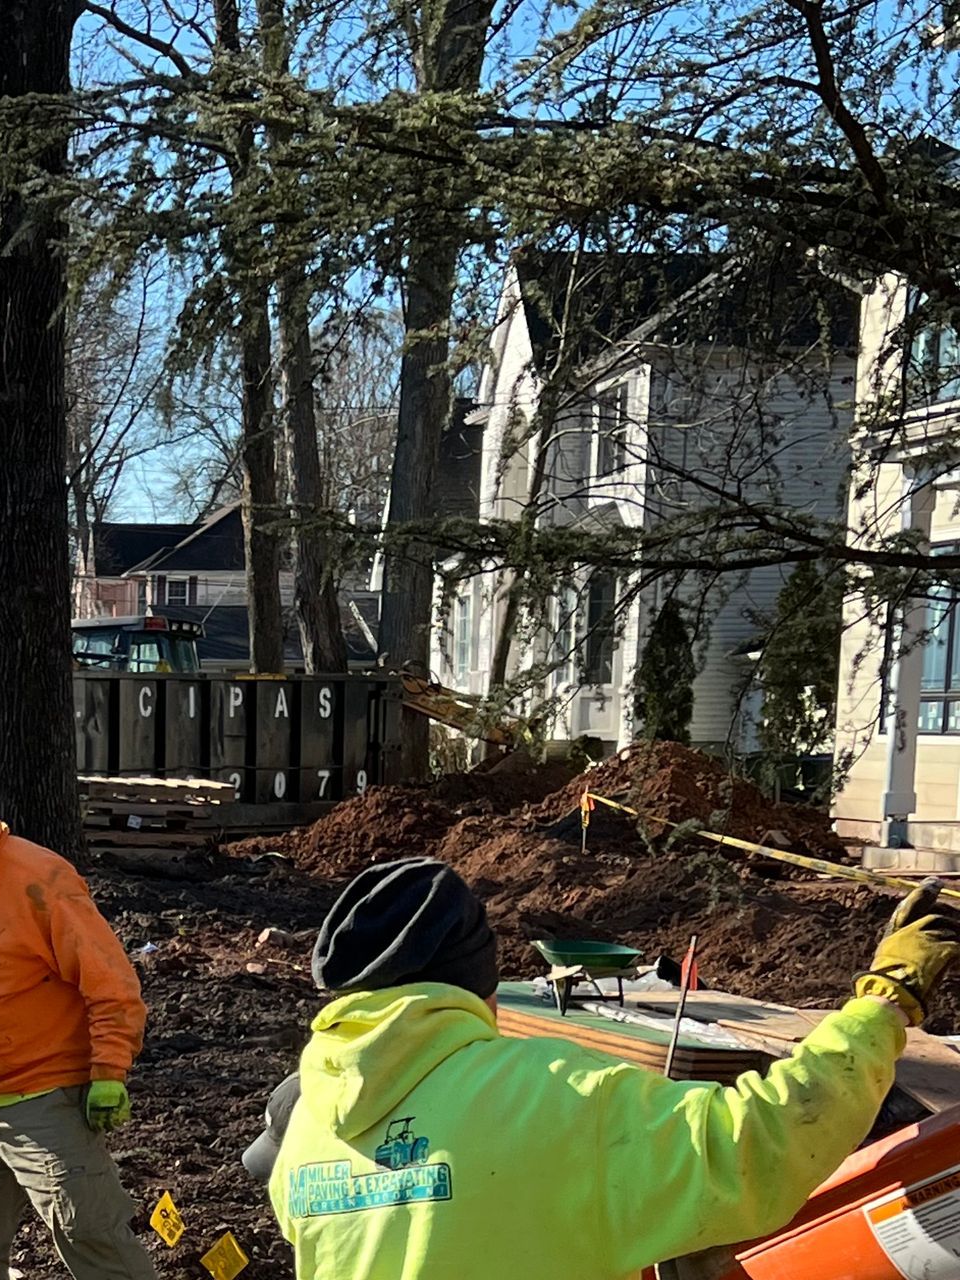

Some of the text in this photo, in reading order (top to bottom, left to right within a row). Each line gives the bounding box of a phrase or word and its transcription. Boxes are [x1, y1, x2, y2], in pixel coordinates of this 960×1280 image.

[308, 1164, 349, 1181] MILLER
[308, 1181, 349, 1201] PAVING
[365, 1166, 447, 1193] EXCAVATING
[909, 1174, 960, 1205] WARNING
